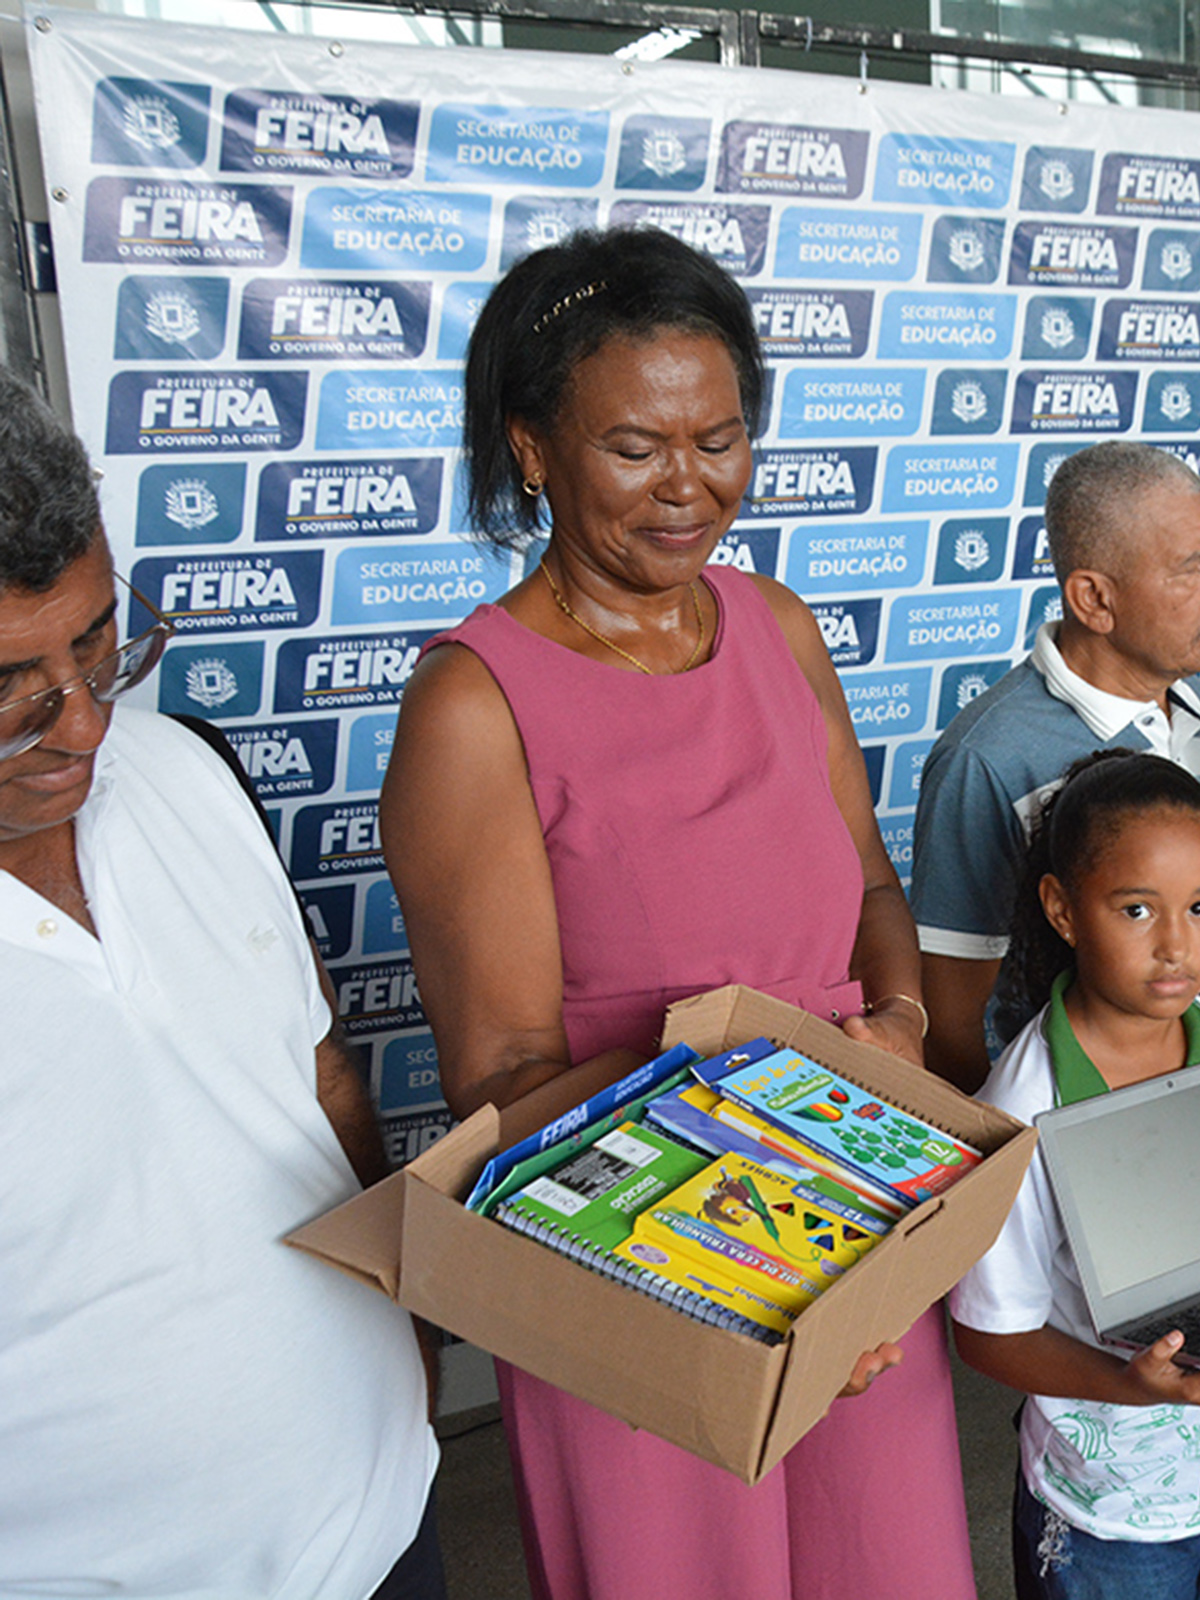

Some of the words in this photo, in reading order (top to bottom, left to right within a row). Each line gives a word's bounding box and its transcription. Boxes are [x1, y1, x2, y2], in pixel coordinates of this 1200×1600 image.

[270, 98, 346, 112] PREFEITURA
[253, 108, 390, 154] FEIRA
[453, 119, 553, 140] SECRETARIA
[557, 124, 579, 141] DE
[756, 128, 813, 141] PREFEITURA
[267, 154, 331, 169] GOVERNO
[354, 159, 391, 172] GENTE
[455, 144, 581, 170] EDUCAÇÃO
[742, 137, 845, 178] FEIRA
[896, 147, 972, 167] SECRETARIA
[976, 153, 992, 169] DE
[752, 177, 800, 190] GOVERNO
[817, 181, 846, 193] GENTE
[896, 168, 994, 193] EDUCAÇÃO
[1117, 167, 1200, 203] FEIRA
[135, 185, 215, 199] PREFEITURA
[118, 196, 262, 242] FEIRA
[330, 204, 434, 225] SECRETARIA
[439, 209, 461, 226] DE
[798, 221, 878, 240] SECRETARIA
[881, 226, 899, 241] DE
[133, 244, 200, 258] GOVERNO
[224, 247, 264, 260] GENTE
[332, 229, 464, 256] EDUCAÇÃO
[1030, 236, 1117, 270] FEIRA
[798, 243, 900, 267] EDUCAÇÃO
[287, 286, 360, 296] PREFEITURA
[270, 296, 402, 336] FEIRA
[752, 303, 852, 338] FEIRA
[899, 304, 975, 320] SECRETARIA
[978, 306, 995, 321] DE
[900, 323, 996, 346] EDUCAÇÃO
[1117, 312, 1199, 344] FEIRA
[284, 341, 345, 353] GOVERNO
[367, 342, 404, 354] GENTE
[156, 377, 233, 387] PREFEITURA
[802, 382, 882, 397] SECRETARIA
[885, 382, 902, 396] DE
[346, 386, 447, 403] SECRETARIA
[1032, 383, 1118, 414] FEIRA
[140, 388, 279, 428] FEIRA
[803, 400, 904, 423] EDUCAÇÃO
[154, 433, 219, 446] GOVERNO
[243, 432, 280, 444] GENTE
[302, 466, 373, 477] PREFEITURA
[903, 457, 978, 473] SECRETARIA
[981, 456, 998, 471] DE
[754, 461, 855, 497] FEIRA
[904, 474, 999, 497] EDUCAÇÃO
[287, 475, 415, 516] FEIRA
[300, 519, 359, 533] GOVERNO
[381, 517, 416, 530] GENTE
[806, 535, 885, 553] SECRETARIA
[888, 534, 906, 549] DE
[176, 560, 250, 572] PREFEITURA
[357, 557, 456, 578] SECRETARIA
[461, 556, 482, 573] DE
[807, 552, 907, 576] EDUCAÇÃO
[160, 568, 295, 612] FEIRA
[360, 576, 485, 604] EDUCAÇÃO
[174, 614, 237, 629] GOVERNO
[260, 610, 296, 624] GENTE
[906, 604, 980, 622] SECRETARIA
[983, 602, 999, 617] DE
[907, 620, 1001, 645] EDUCAÇÃO
[319, 639, 389, 653] PREFEITURA
[392, 637, 408, 648] DE
[302, 697, 314, 708] O
[316, 692, 375, 707] GOVERNO
[377, 691, 394, 702] DA
[846, 686, 890, 701] ETARIA
[892, 683, 909, 697] DE
[851, 700, 911, 725] CAÇÃO
[273, 729, 288, 739] DE
[256, 782, 275, 794] DA
[277, 779, 314, 792] GENTE
[320, 816, 382, 855] FEI
[318, 862, 329, 872] O
[351, 965, 414, 980] PREFEITUR
[339, 973, 421, 1016] FEIR
[653, 1210, 727, 1252] TRIANGULAR
[729, 1247, 760, 1266] CERA
